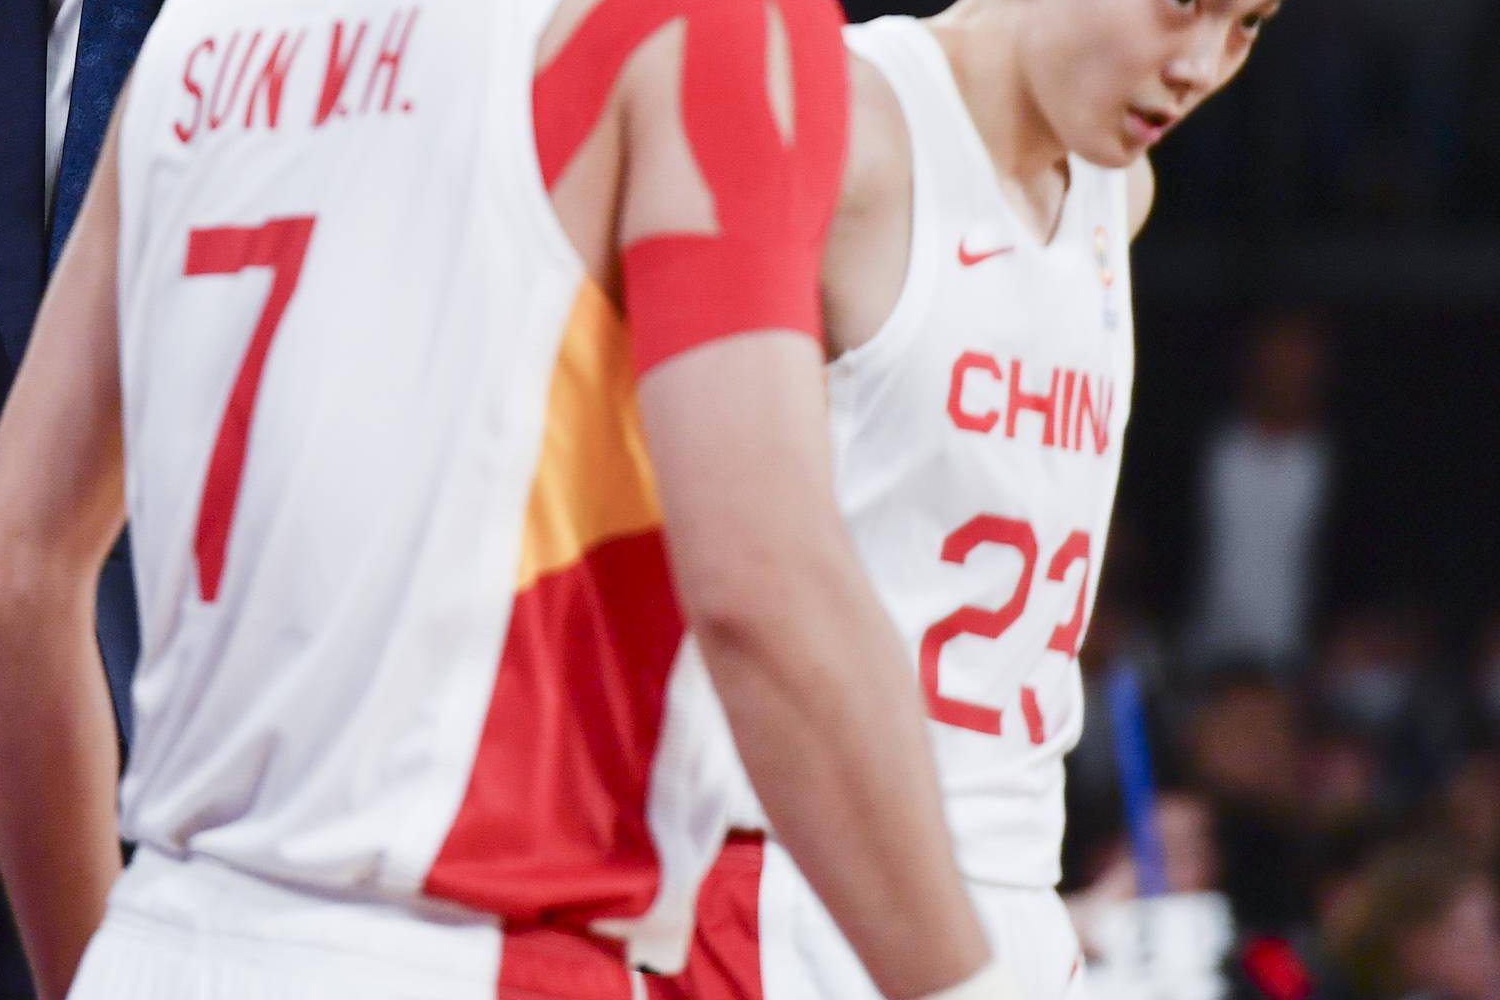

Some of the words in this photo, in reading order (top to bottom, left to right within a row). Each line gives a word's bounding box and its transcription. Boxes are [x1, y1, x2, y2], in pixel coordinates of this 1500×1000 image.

[172, 26, 306, 145] SUN
[181, 213, 318, 605] 7
[945, 349, 1113, 456] CHIN
